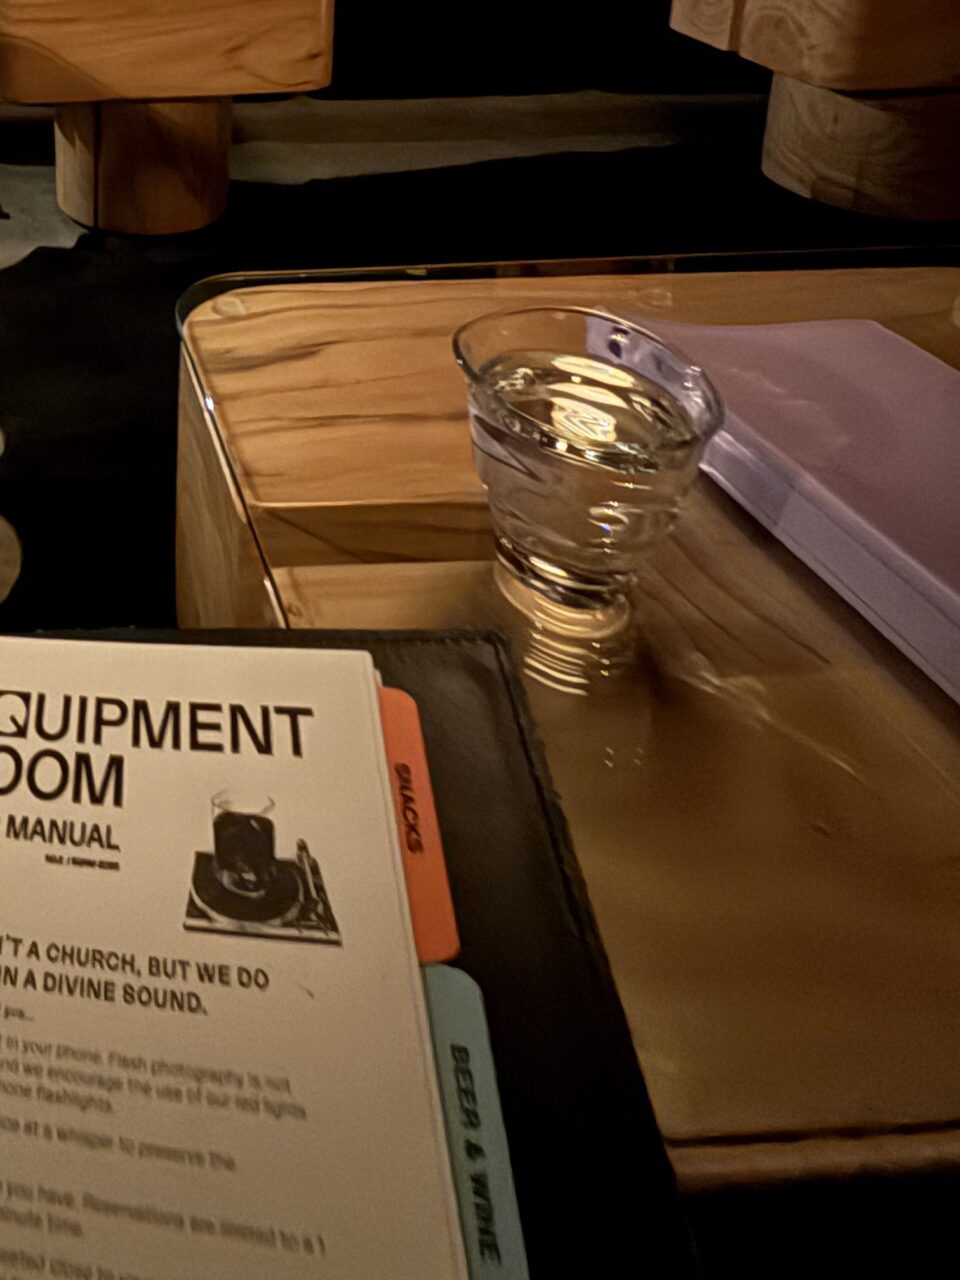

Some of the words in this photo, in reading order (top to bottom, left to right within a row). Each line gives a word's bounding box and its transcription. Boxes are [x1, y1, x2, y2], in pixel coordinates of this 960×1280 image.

[5, 814, 121, 853] MANUAL
[395, 763, 424, 855] SNACKS
[27, 940, 41, 960] A
[46, 942, 142, 978] CHURCH,
[148, 956, 192, 981] BUT
[195, 961, 231, 987] WE
[237, 965, 270, 991] DO
[23, 969, 37, 990] A
[42, 972, 116, 1003] DIVINE
[122, 983, 209, 1016] SOUND.
[21, 1040, 53, 1058] your
[450, 1043, 481, 1132] BEER
[470, 1170, 502, 1267] WINE
